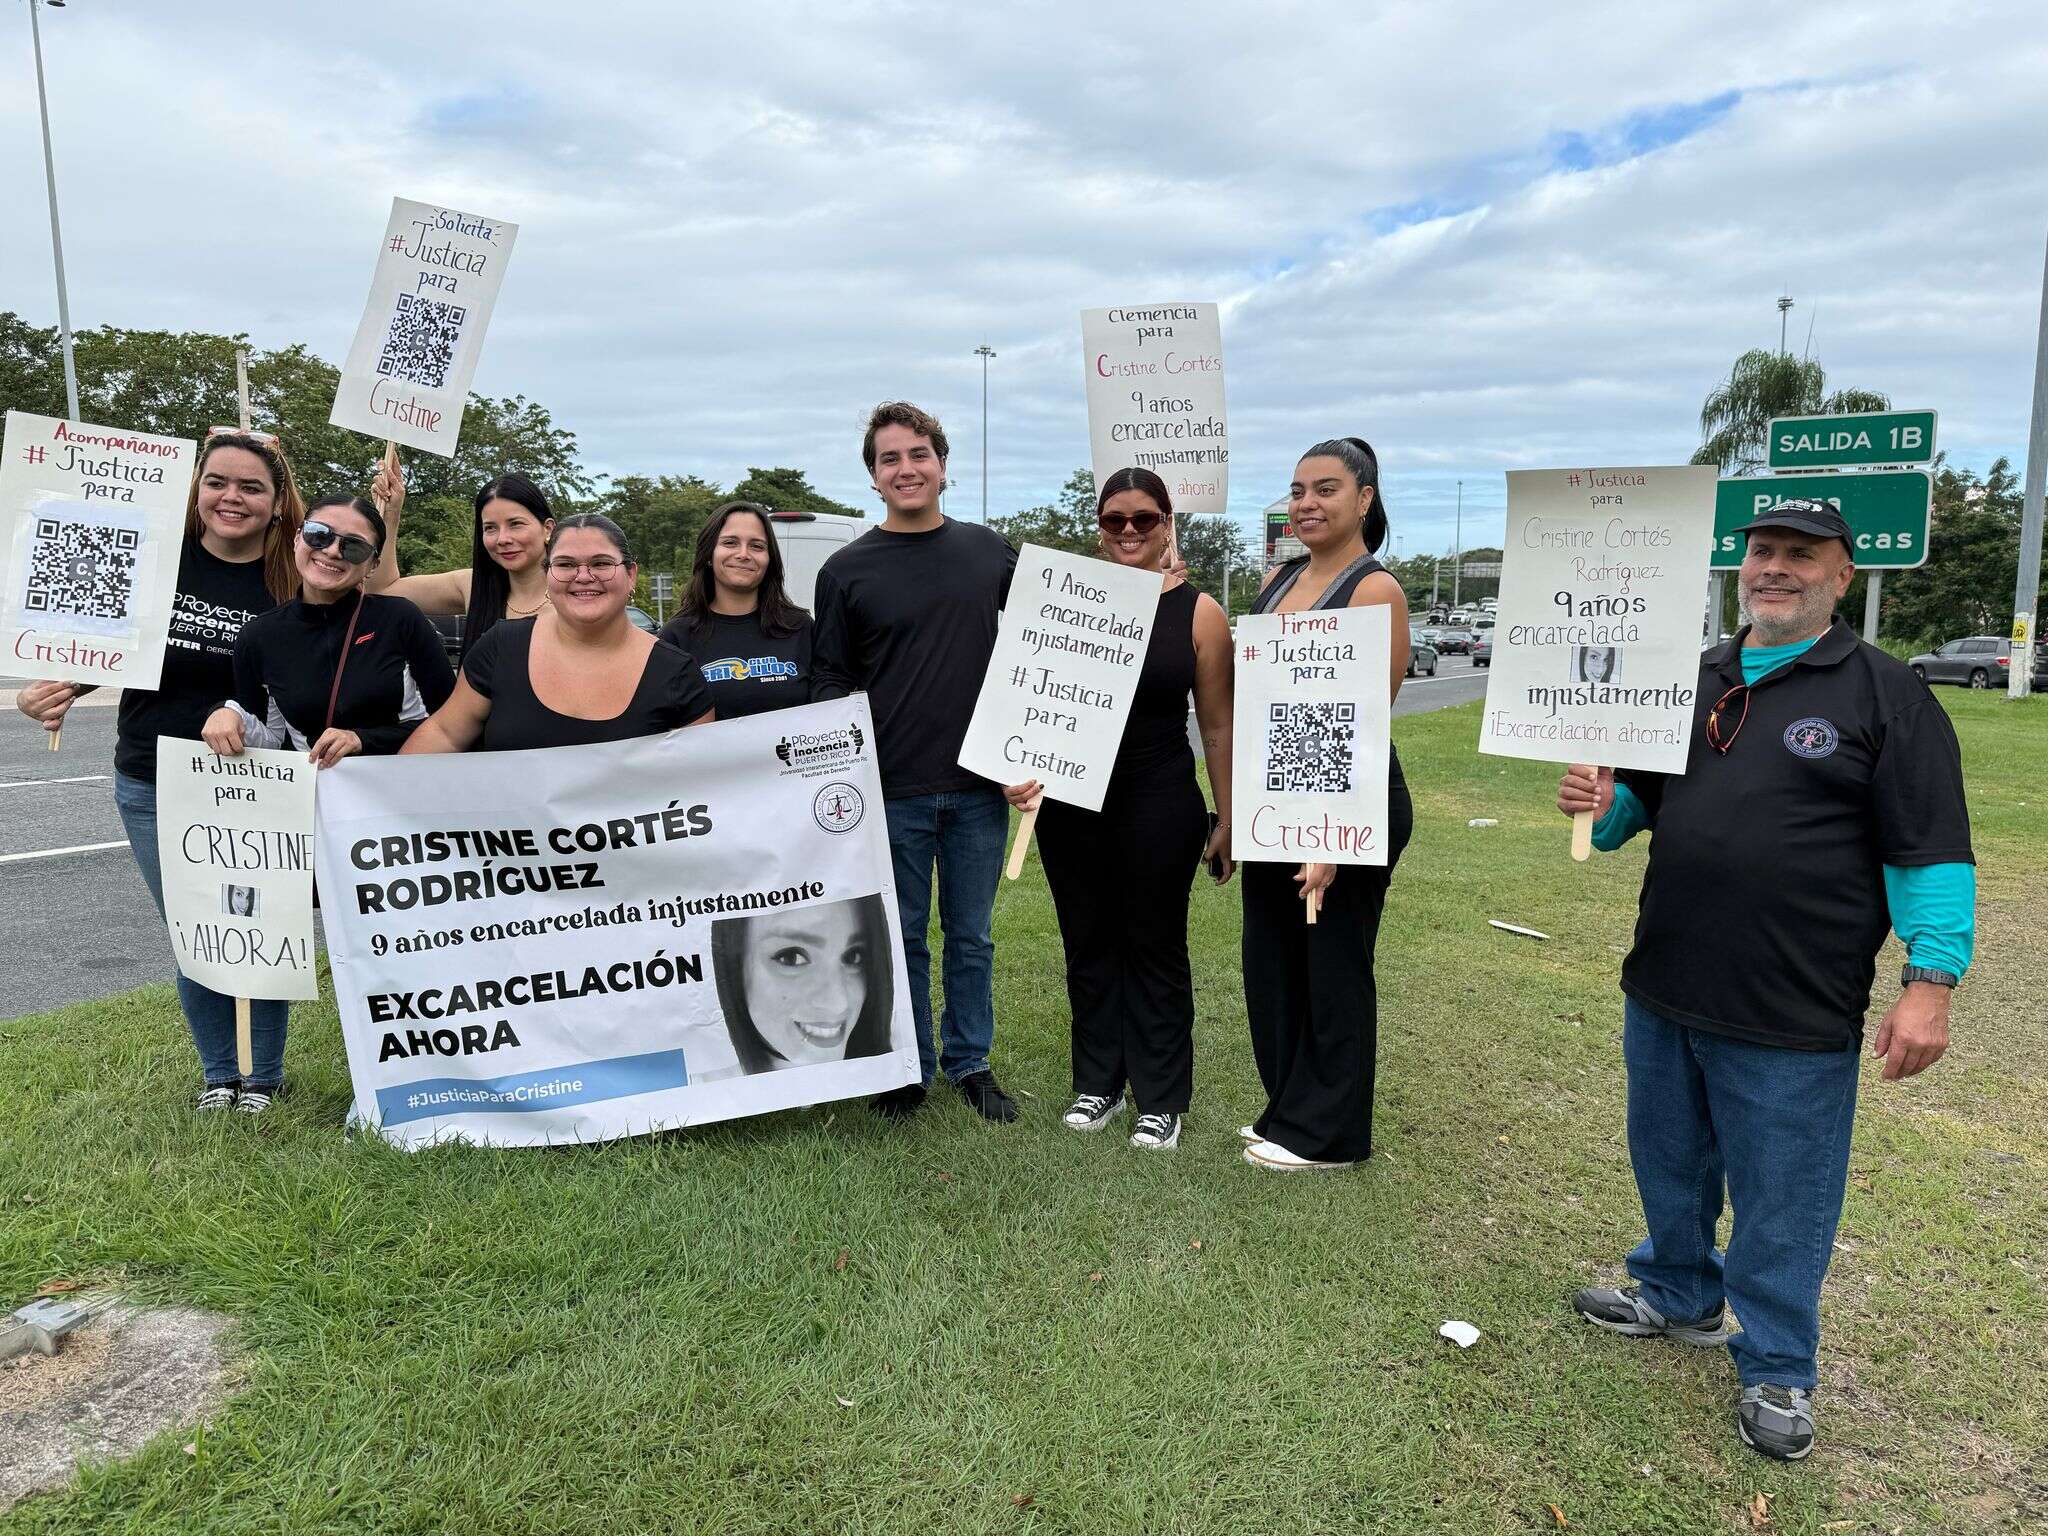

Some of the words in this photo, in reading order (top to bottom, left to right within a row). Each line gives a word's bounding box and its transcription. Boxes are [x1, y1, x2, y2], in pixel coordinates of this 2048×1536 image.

[435, 210, 492, 241] Solicita
[416, 271, 458, 294] para
[1108, 307, 1198, 323] Clemencia
[1136, 325, 1174, 346] para
[1097, 353, 1158, 378] Cristine
[1164, 351, 1222, 375] Cortés
[369, 378, 442, 432] Cristine
[1131, 391, 1144, 414] 9
[1149, 396, 1194, 414] años
[53, 421, 181, 460] Acompañanos
[1111, 416, 1226, 442] encarcelada
[1779, 431, 1872, 453] SALIDA
[1889, 426, 1923, 449] 1B
[1134, 445, 1229, 472] injustamente
[80, 480, 136, 504] para
[1178, 478, 1221, 496] ahora!
[1590, 494, 1624, 509] para
[1522, 516, 1594, 550] Cristine
[1604, 517, 1672, 549] Cortés
[1041, 567, 1053, 589] 9
[1060, 571, 1108, 604] Años
[1570, 554, 1665, 595] Rodríguez
[1554, 590, 1573, 618] 9
[1579, 594, 1647, 618] años
[168, 621, 217, 639] UERTO
[1039, 603, 1144, 641] encarcelada
[1278, 612, 1339, 635] Firma
[1508, 616, 1640, 646] encarcelada
[14, 628, 125, 672] Cristine
[167, 637, 201, 651] NTER
[206, 645, 235, 656] DEREC
[1021, 626, 1135, 667] injustamente
[1289, 665, 1338, 684] para
[1527, 683, 1694, 719] injustamente
[1023, 706, 1078, 733] para
[1490, 710, 1609, 744] ¡Excarcelación
[1617, 719, 1682, 746] ahora!
[794, 740, 850, 756] Inocencia
[795, 753, 828, 764] PUERTO
[1003, 735, 1088, 780] Cristine
[214, 785, 257, 806] para
[350, 827, 540, 872] CRISTINE
[547, 801, 714, 855] CORTÉS
[1251, 804, 1376, 857] Cristine
[182, 823, 315, 871] CRISTINE
[356, 860, 606, 915] RODRÍGUEZ
[371, 933, 389, 956] 9
[395, 928, 464, 954] años
[470, 903, 644, 943] encarcelada
[648, 880, 826, 931] injustamente
[176, 921, 308, 970] ¡AHORA!
[367, 950, 704, 1023] EXCARCELACIÓN
[378, 1019, 521, 1063] AHORA
[407, 1080, 583, 1109] #JusticiaParaCristine
